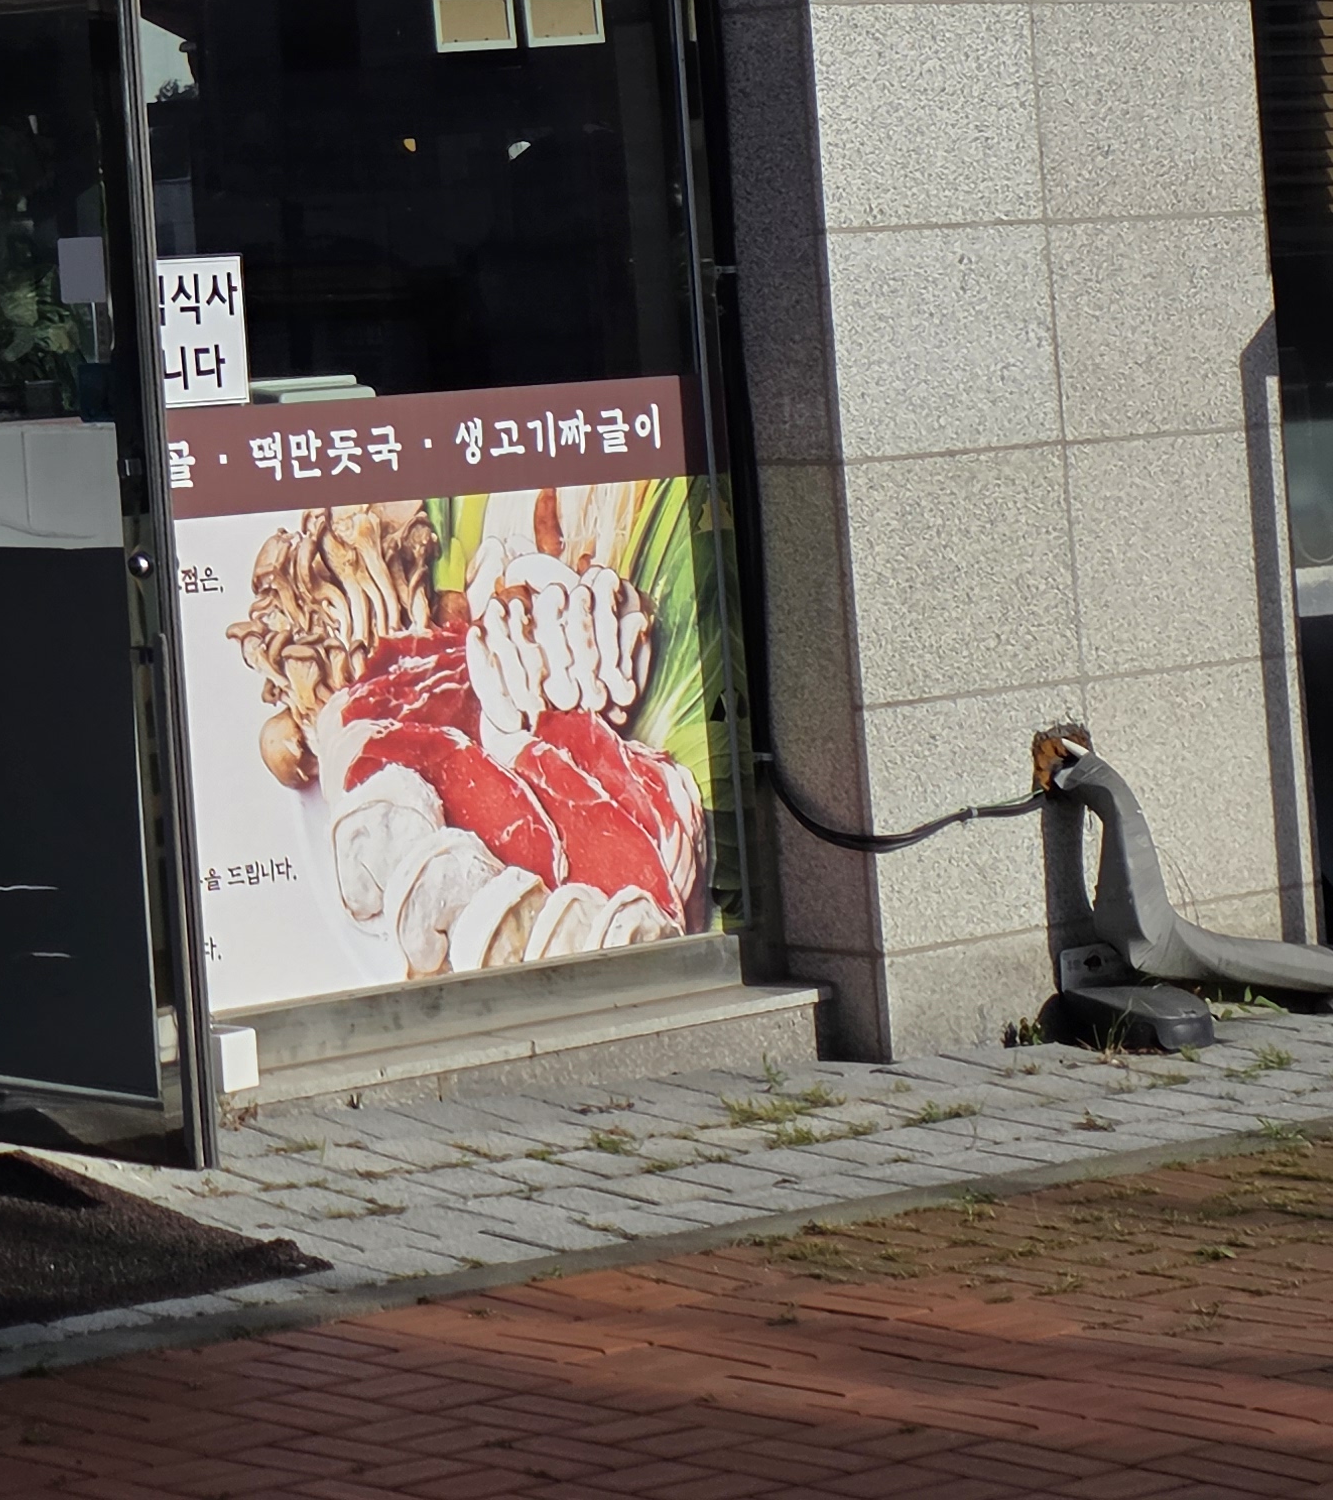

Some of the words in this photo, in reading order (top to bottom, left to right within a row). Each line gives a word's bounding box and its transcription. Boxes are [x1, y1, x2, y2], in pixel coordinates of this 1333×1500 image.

[162, 343, 227, 391] 니다
[249, 424, 403, 482] 떡만둣국
[454, 402, 663, 466] 생고기짜글이
[179, 565, 225, 595] 점은,
[199, 866, 222, 891] 을
[227, 855, 298, 886] 드립니다.
